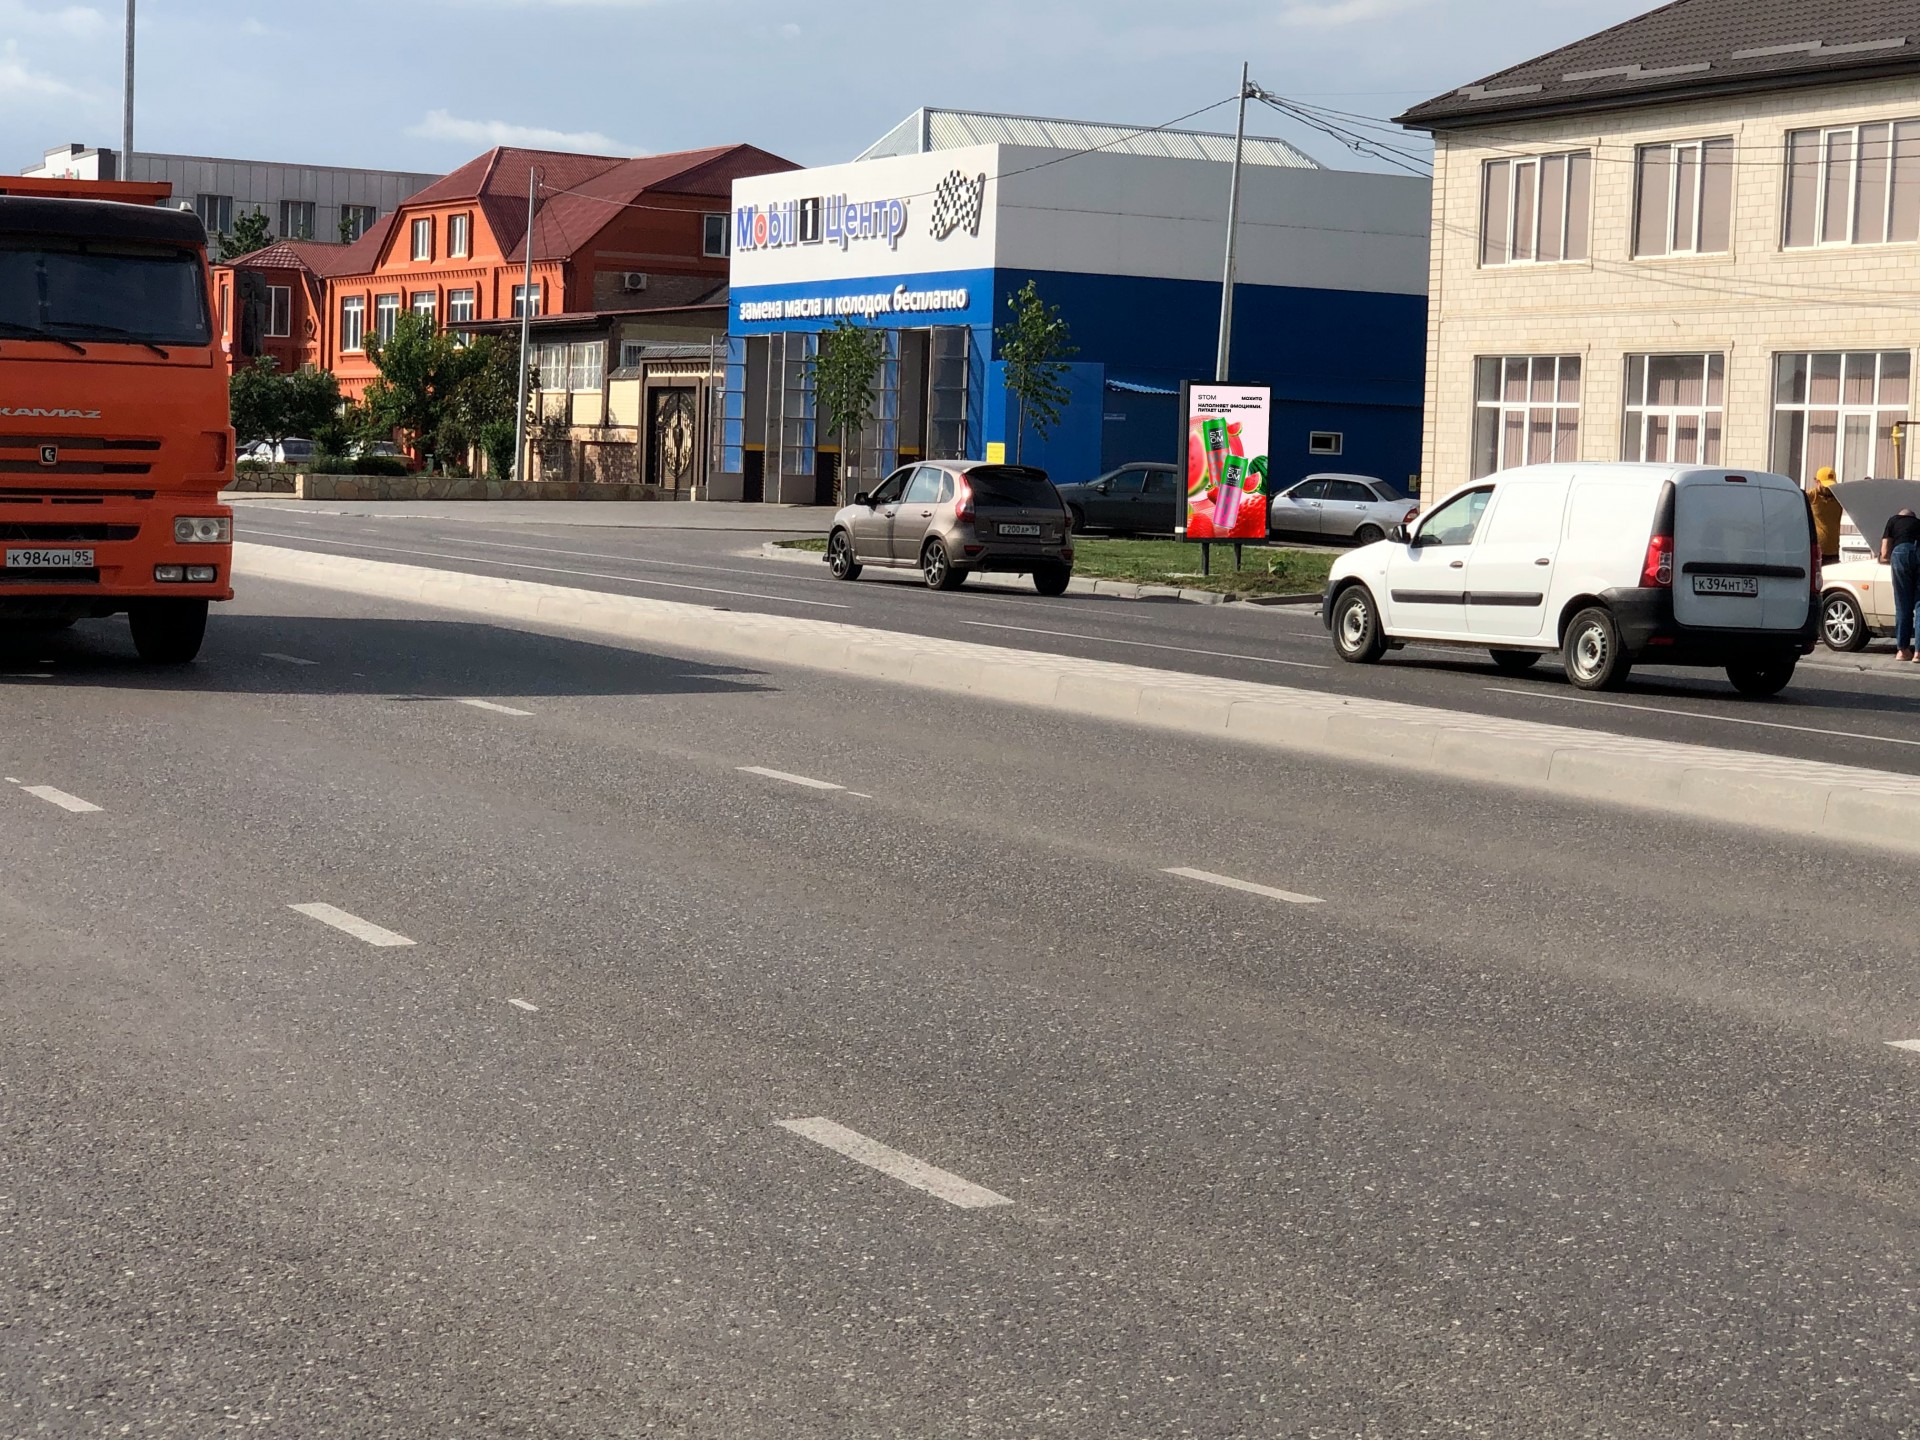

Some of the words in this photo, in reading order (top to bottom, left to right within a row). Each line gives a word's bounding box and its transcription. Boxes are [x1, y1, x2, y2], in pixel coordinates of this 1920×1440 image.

[737, 199, 797, 250] Mobil
[825, 193, 908, 251] Центр
[739, 300, 783, 320] замена
[785, 298, 821, 317] масла
[824, 298, 833, 315] и
[835, 293, 891, 318] колодок
[893, 284, 968, 311] бесплатно
[0, 407, 101, 418] KAMAZ
